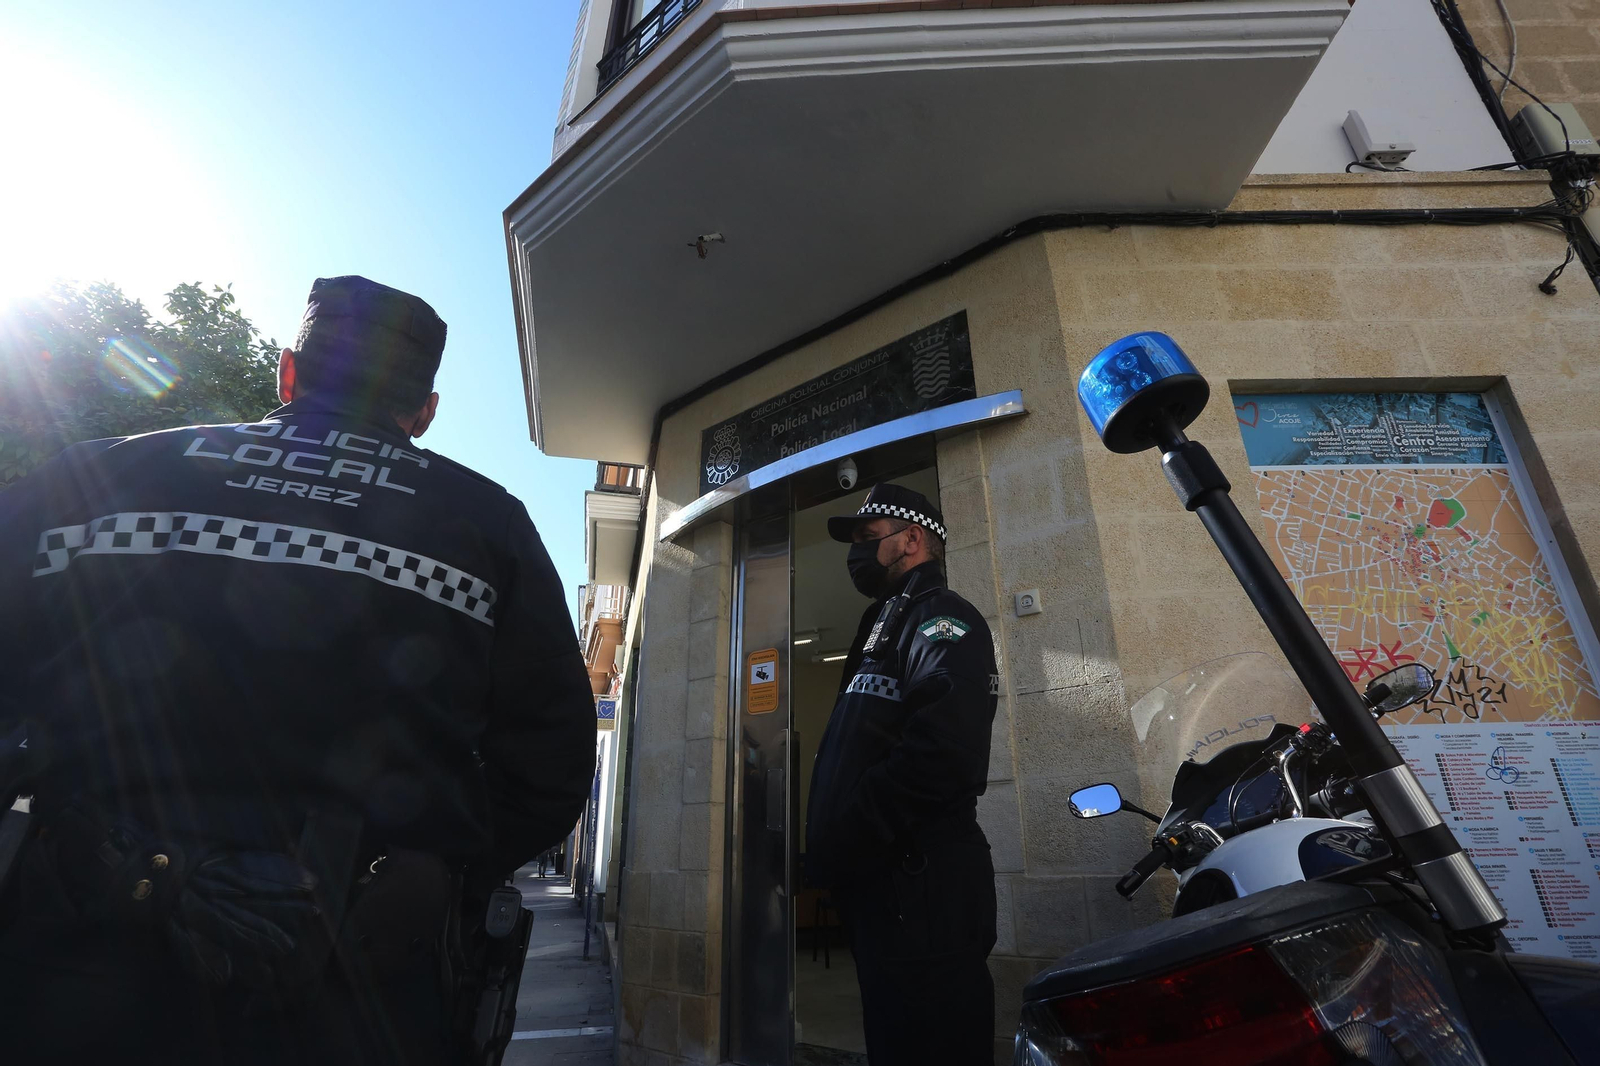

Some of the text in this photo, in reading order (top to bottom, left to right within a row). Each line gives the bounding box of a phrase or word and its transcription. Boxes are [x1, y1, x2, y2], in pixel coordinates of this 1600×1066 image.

[751, 352, 889, 419] OFICINA POLICIAL CONJUNTA
[771, 385, 867, 436] Policía Nacional
[823, 418, 856, 441] Local
[235, 423, 430, 469] OLICIA
[1394, 436, 1434, 446] Centro
[183, 437, 416, 495] LOCAL
[225, 474, 361, 507] JEREZ
[948, 617, 966, 627] LOCAL
